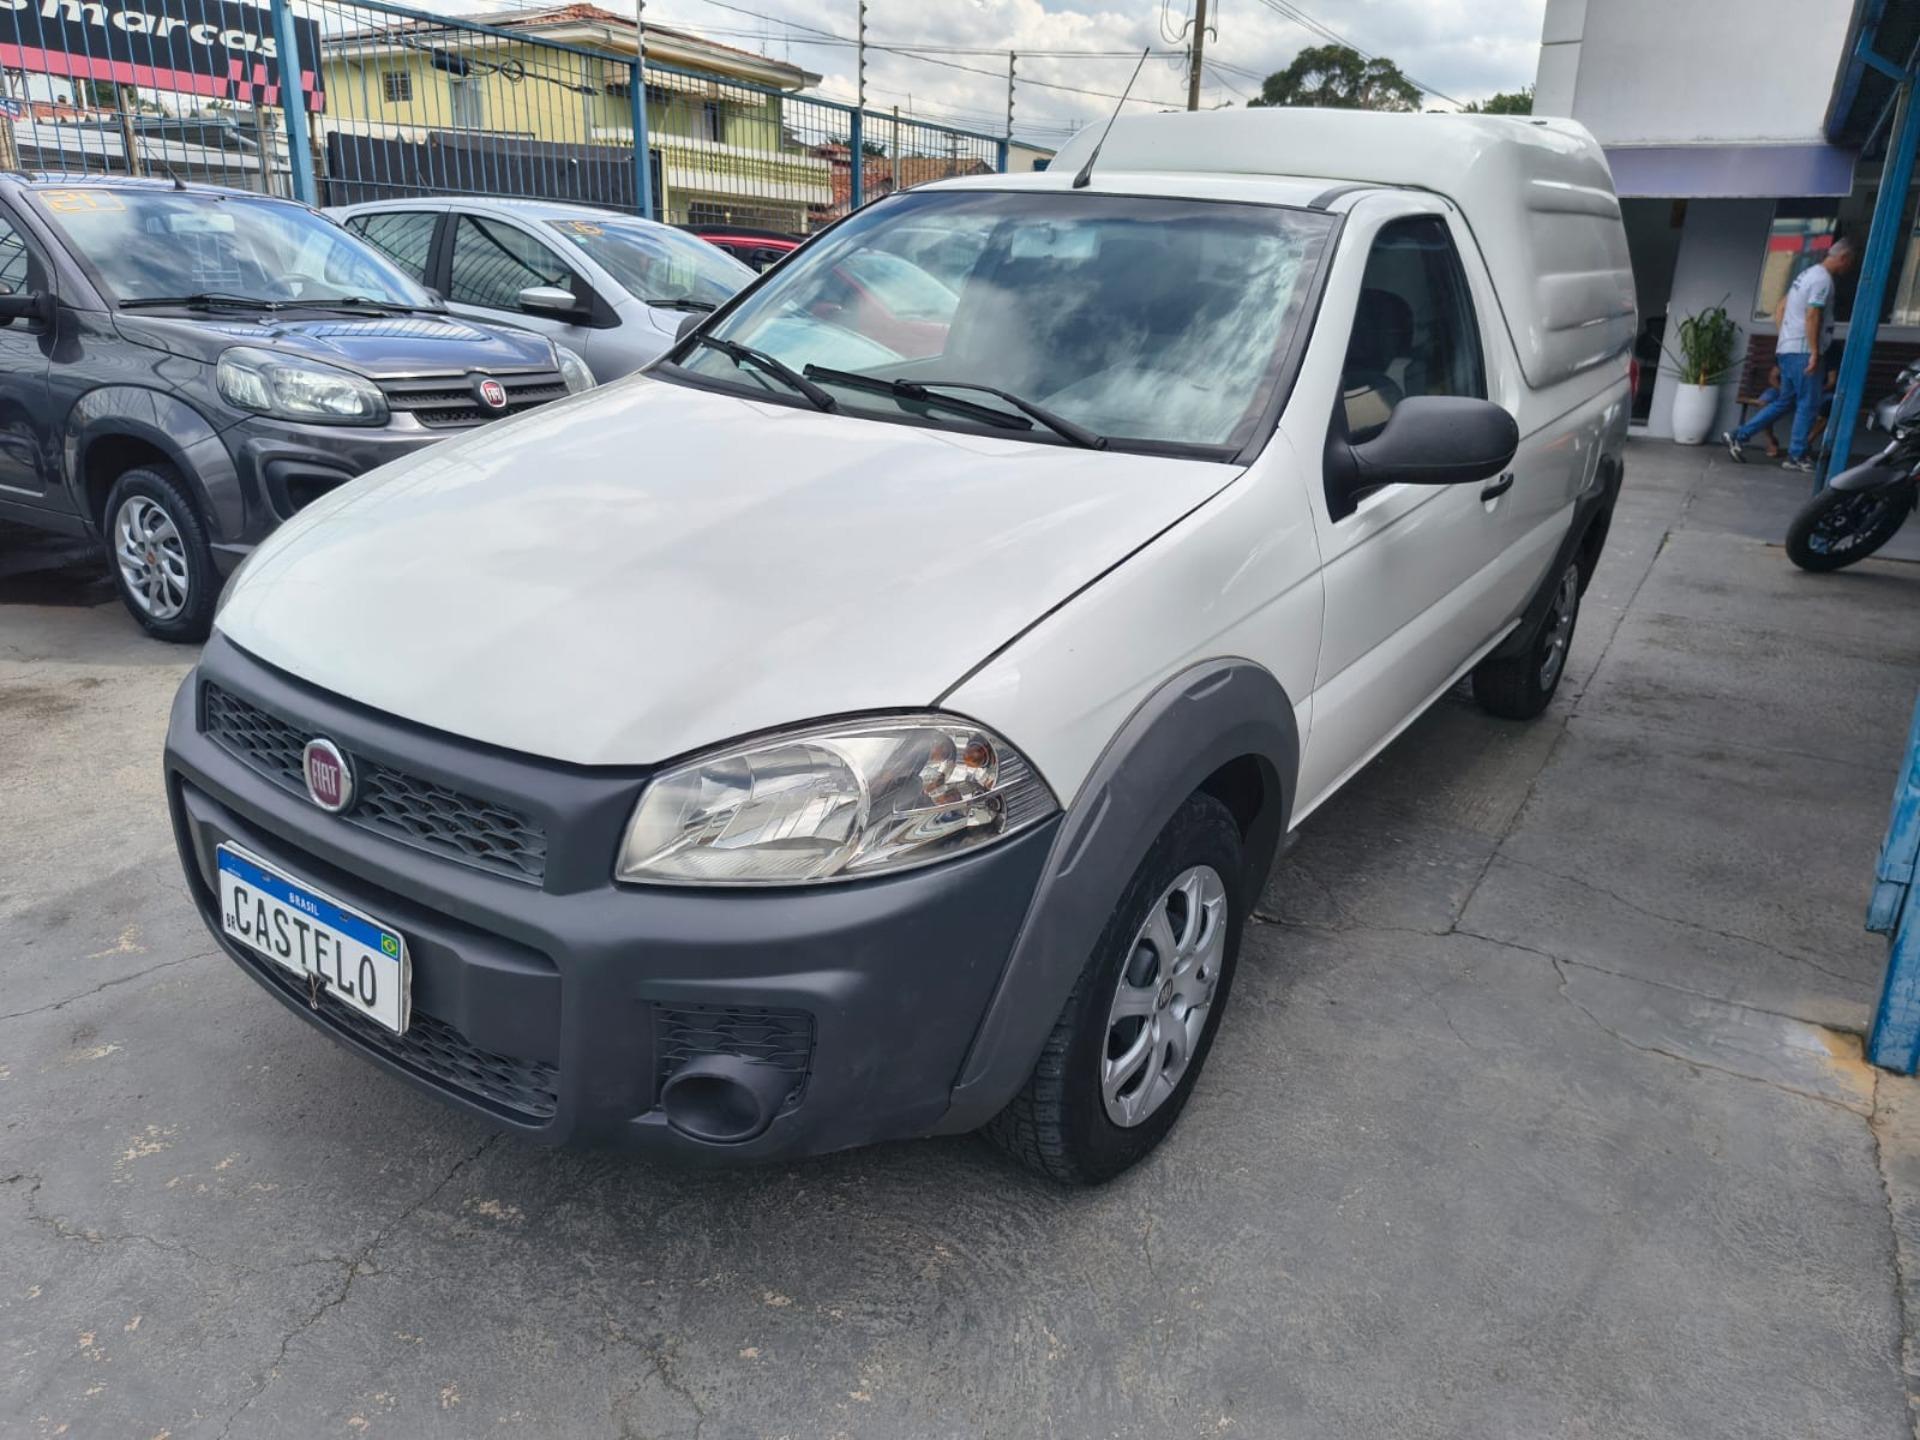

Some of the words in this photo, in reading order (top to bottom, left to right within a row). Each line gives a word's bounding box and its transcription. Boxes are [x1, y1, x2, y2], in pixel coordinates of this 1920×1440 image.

[311, 758, 337, 796] FIAT
[288, 892, 320, 916] BRASIL
[234, 886, 377, 1008] CASTELO
